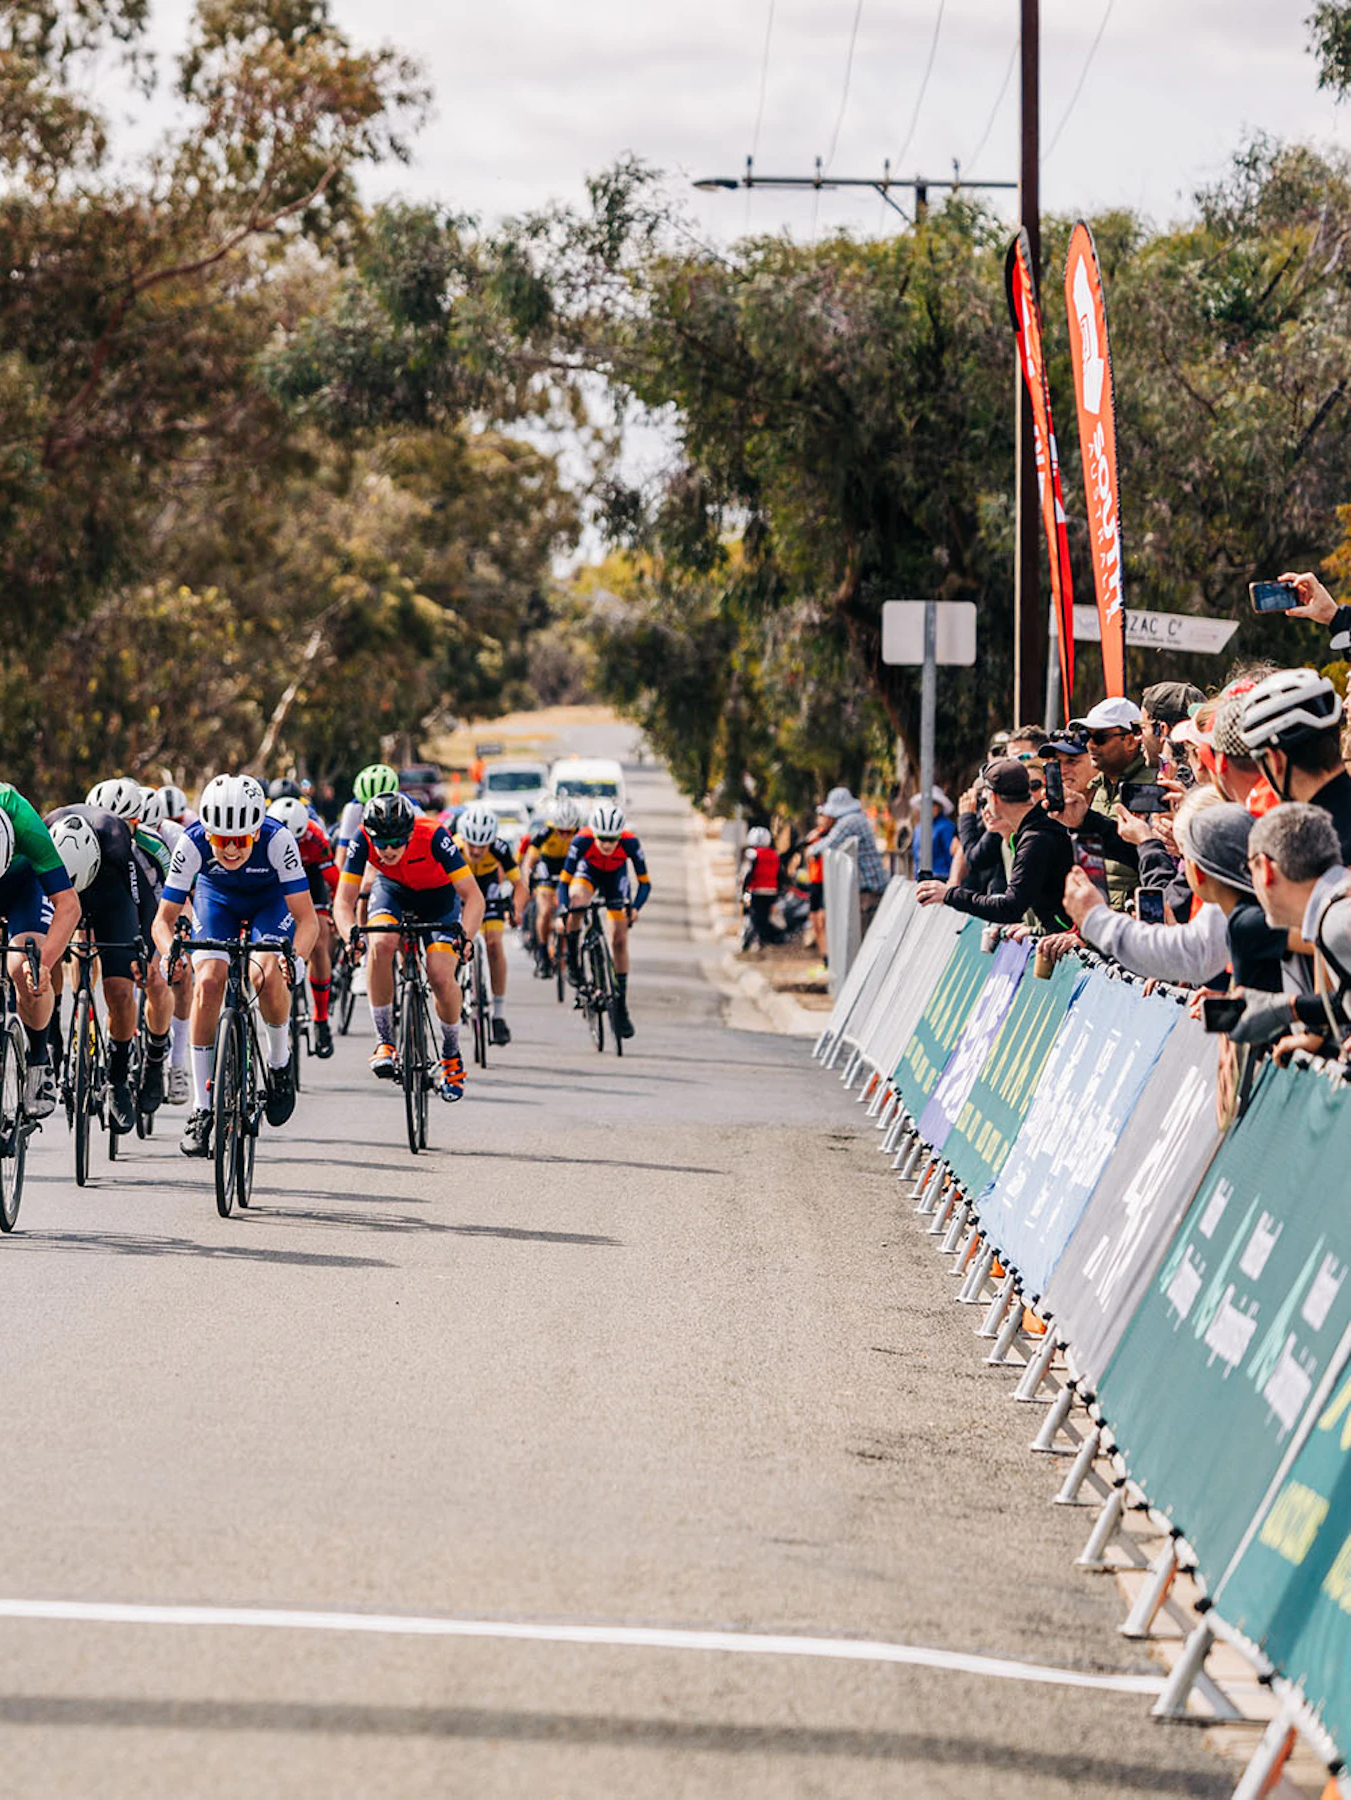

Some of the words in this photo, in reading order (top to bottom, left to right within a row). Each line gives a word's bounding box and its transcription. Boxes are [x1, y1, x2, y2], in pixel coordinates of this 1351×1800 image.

[1126, 615, 1158, 637] ZAC
[283, 844, 298, 870] VIC
[440, 836, 457, 857] SA
[171, 851, 186, 874] VIC
